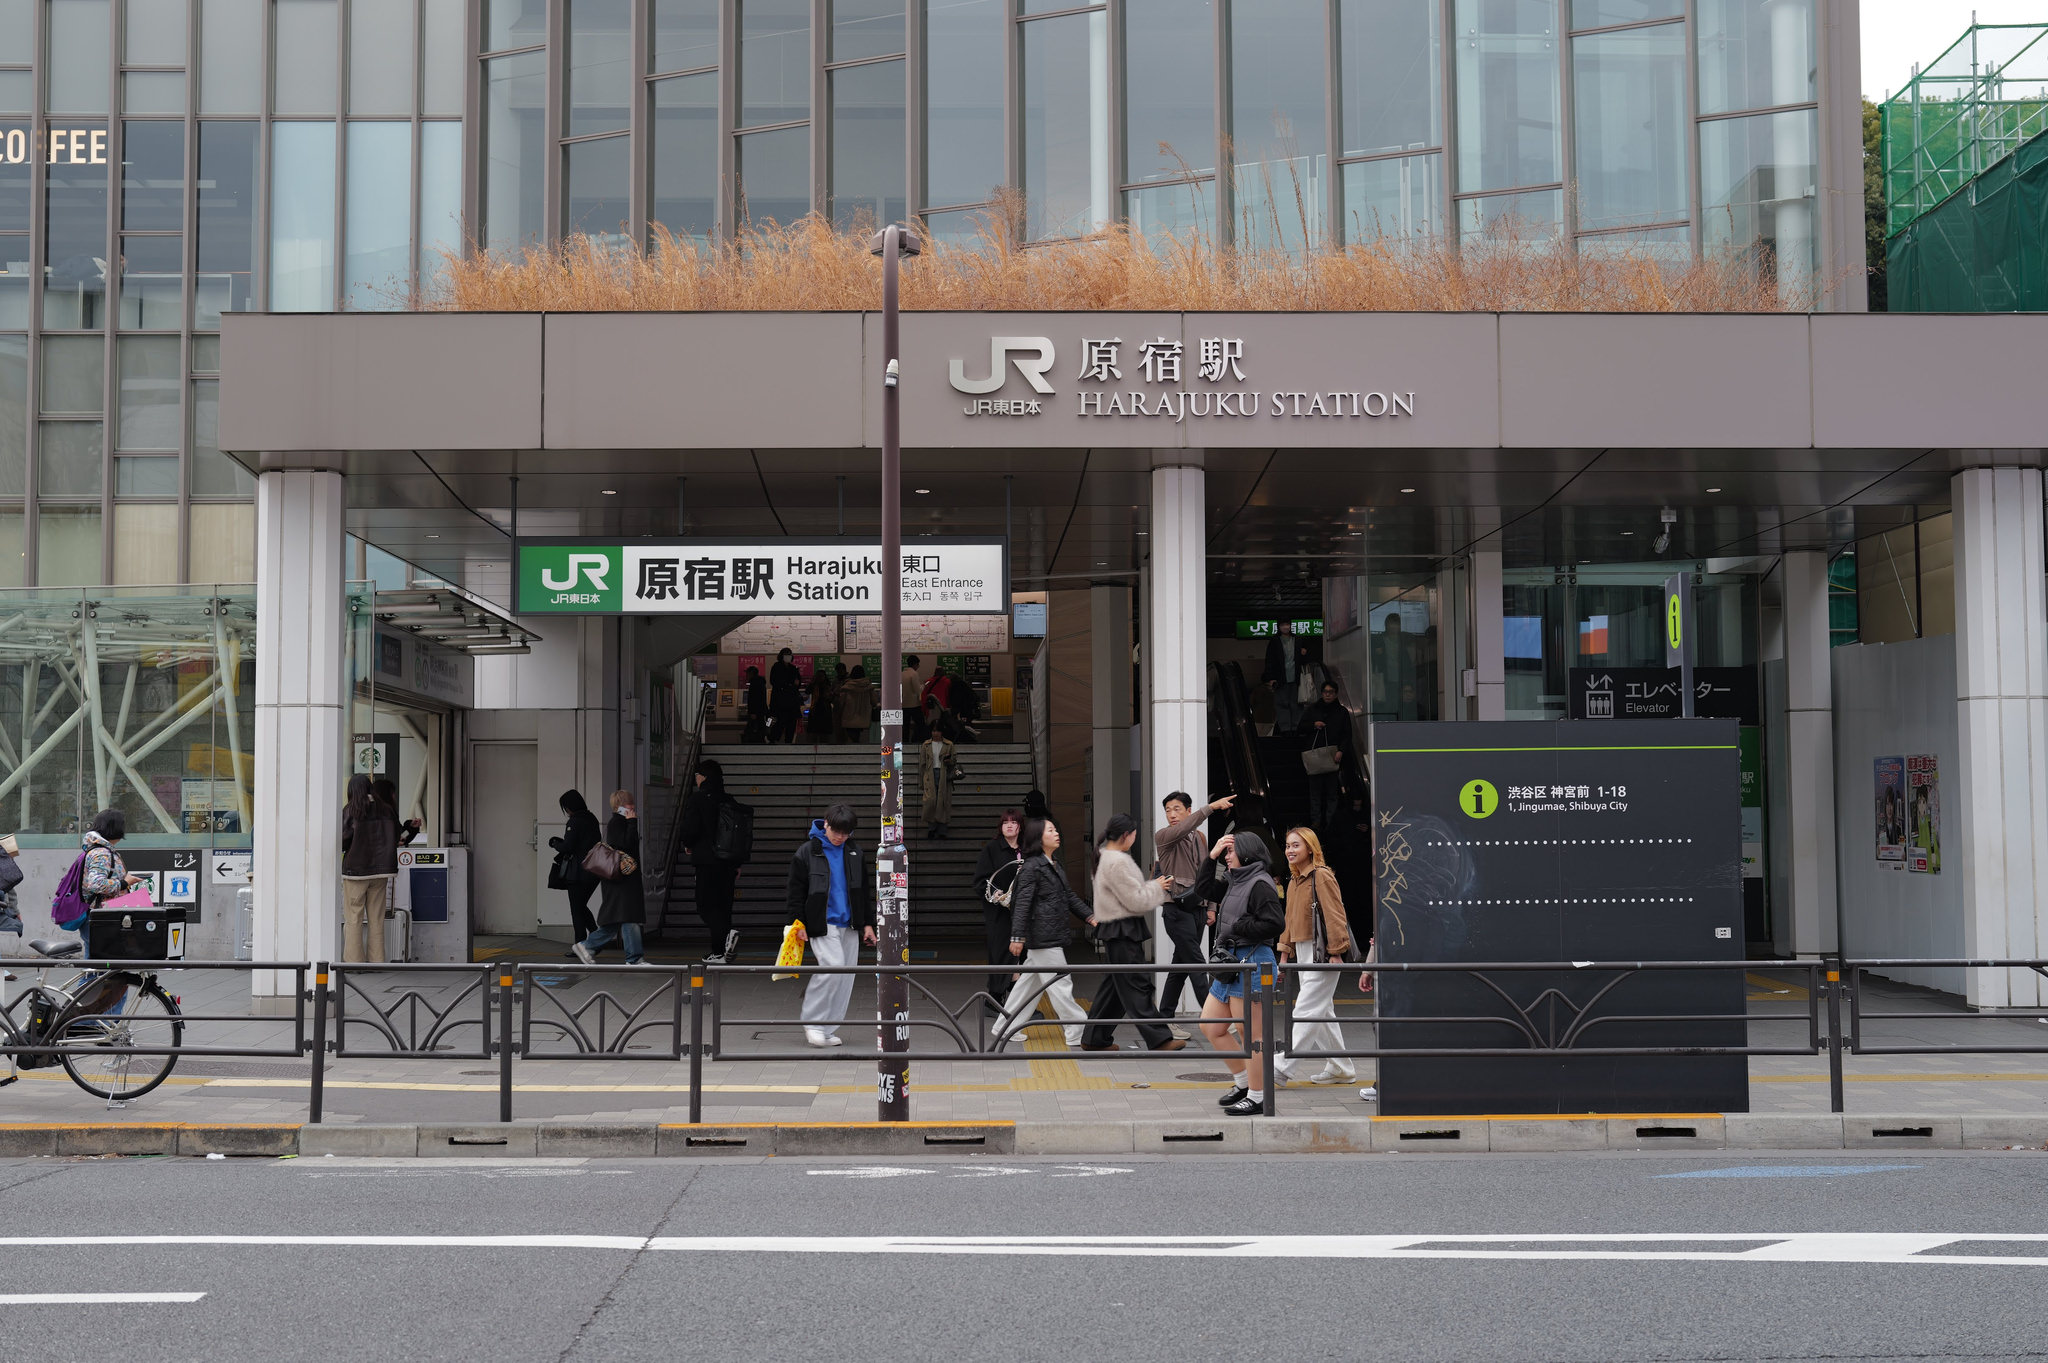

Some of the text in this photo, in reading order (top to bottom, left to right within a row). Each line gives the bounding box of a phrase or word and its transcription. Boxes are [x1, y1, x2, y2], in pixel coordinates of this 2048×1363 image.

[949, 336, 1056, 394] JR
[1077, 336, 1247, 383] 原宿駅
[963, 399, 1043, 416] JR東日本
[1077, 391, 1416, 424] HARAJUKU STATION
[541, 553, 611, 592] JR
[901, 554, 941, 574] 東口
[635, 557, 775, 601] 原宿駅
[901, 577, 984, 589] East Entrance
[550, 593, 601, 604] JR東日本
[786, 580, 870, 601] Station
[901, 590, 932, 602] 东入口
[963, 590, 984, 602] 입구
[1626, 702, 1670, 713] Elevator
[1508, 785, 1627, 799] 渋谷区 神宮前 1-18
[1518, 802, 1568, 813] Jingumae,
[1569, 801, 1607, 812] Shibuya
[1609, 801, 1628, 812] City
[433, 854, 441, 863] 2
